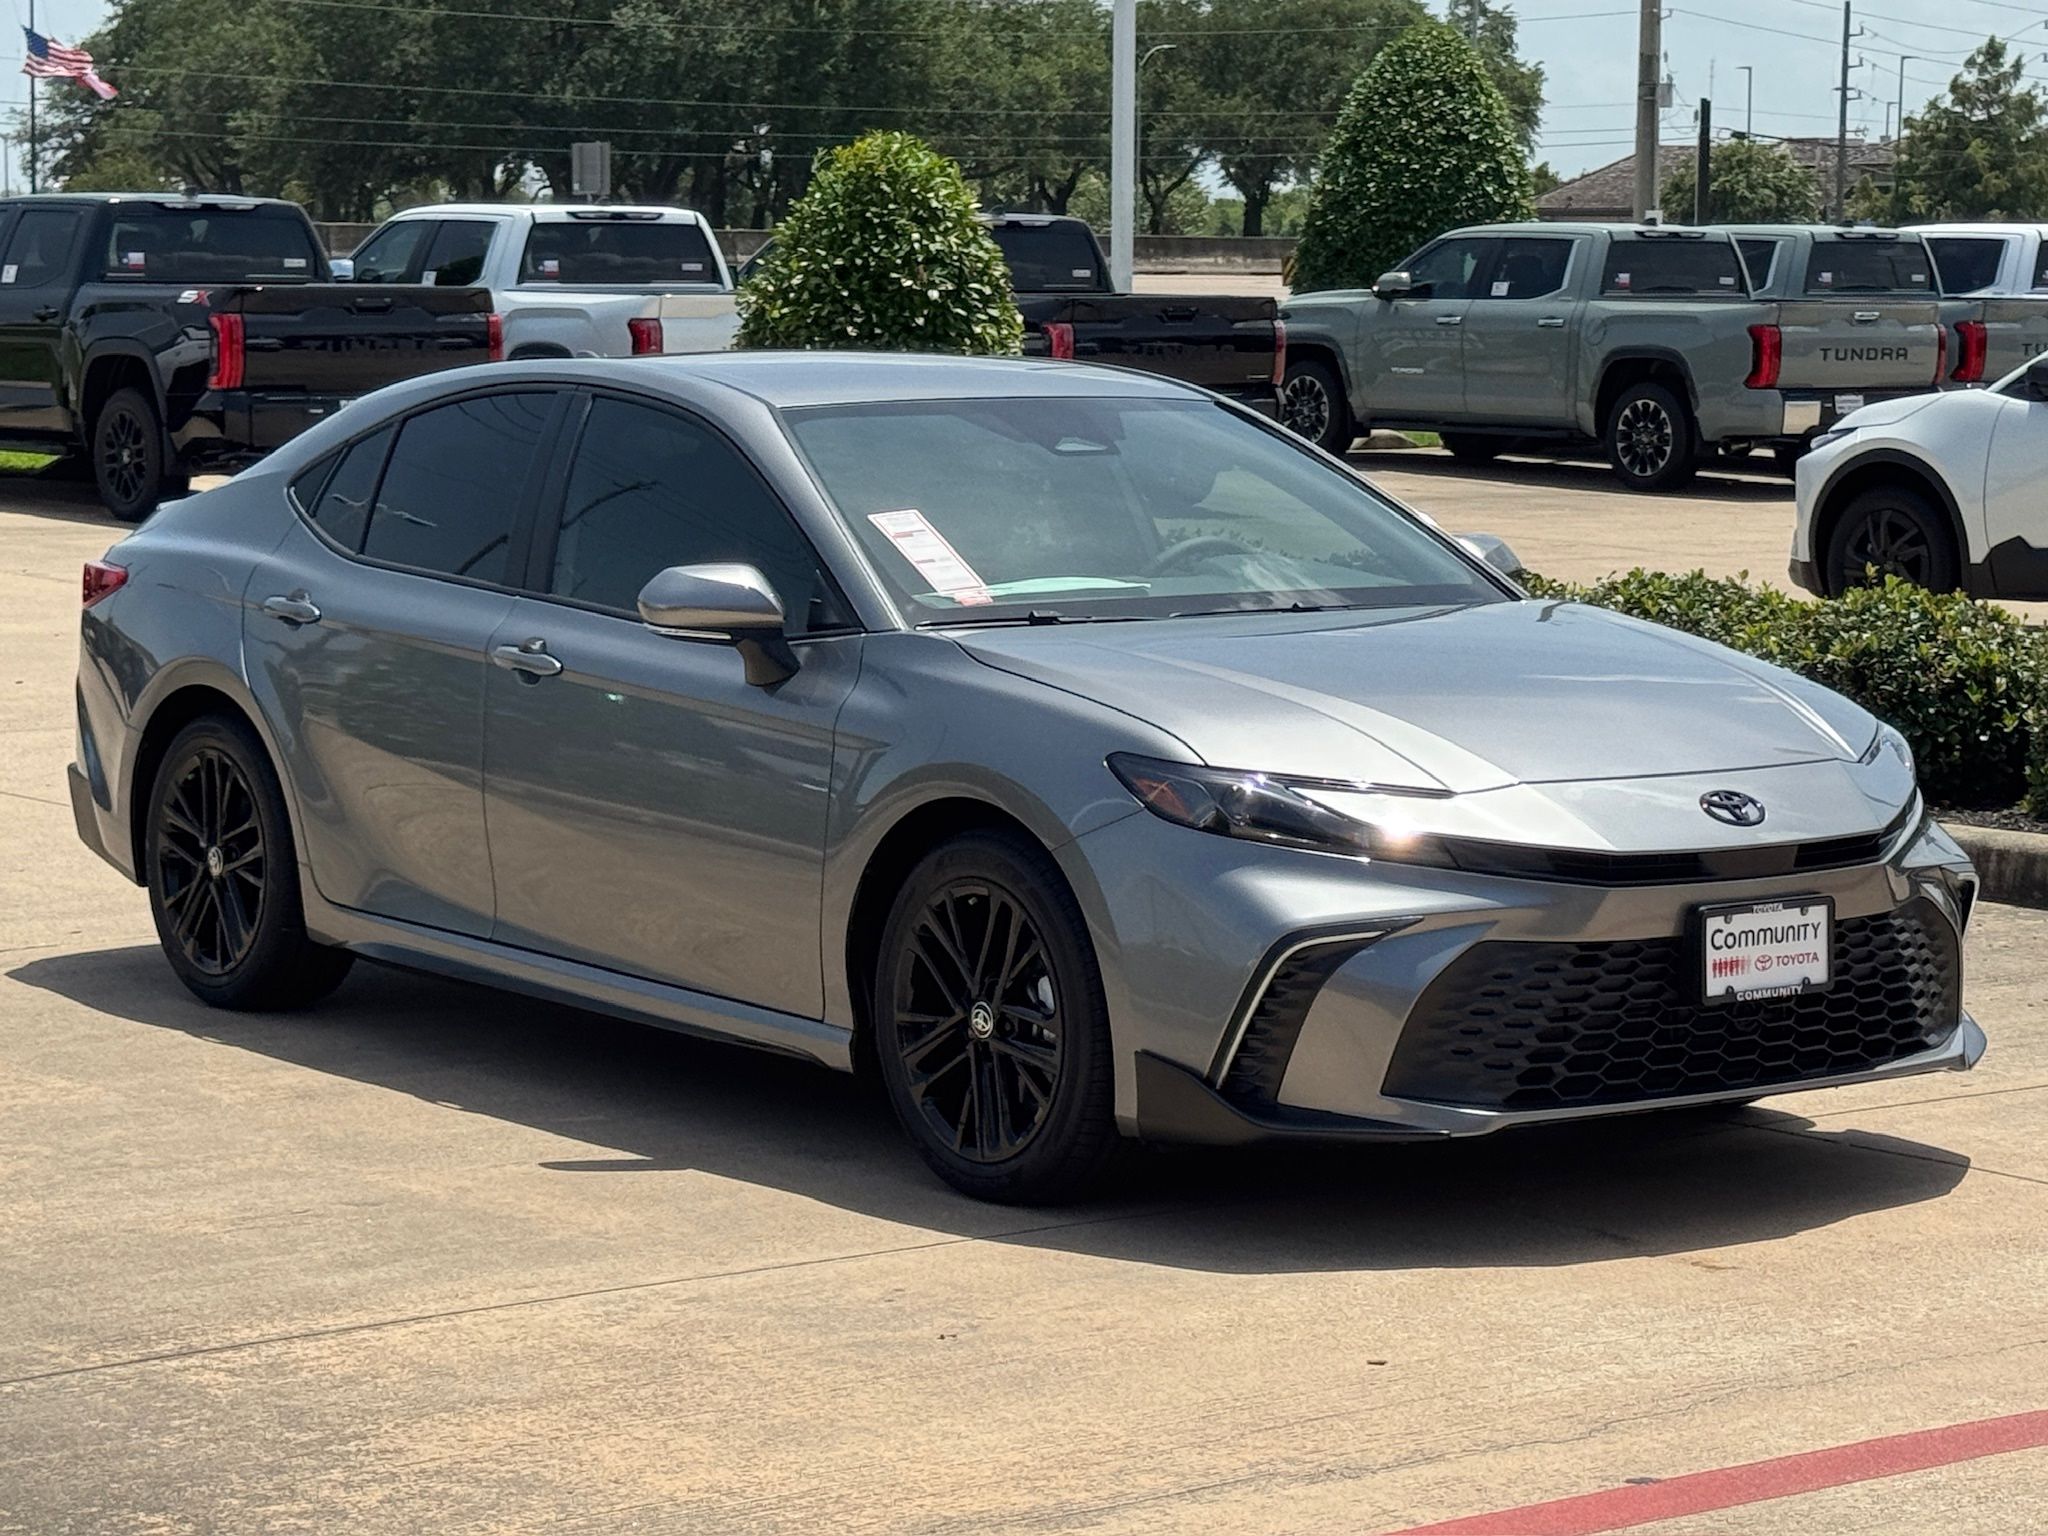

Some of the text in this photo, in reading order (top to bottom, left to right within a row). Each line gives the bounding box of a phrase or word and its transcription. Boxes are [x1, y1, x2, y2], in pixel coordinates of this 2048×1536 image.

[1820, 347, 1908, 361] TUNDRA
[1776, 952, 1819, 967] TOYOTA
[1736, 985, 1803, 1001] COMMUNITY
